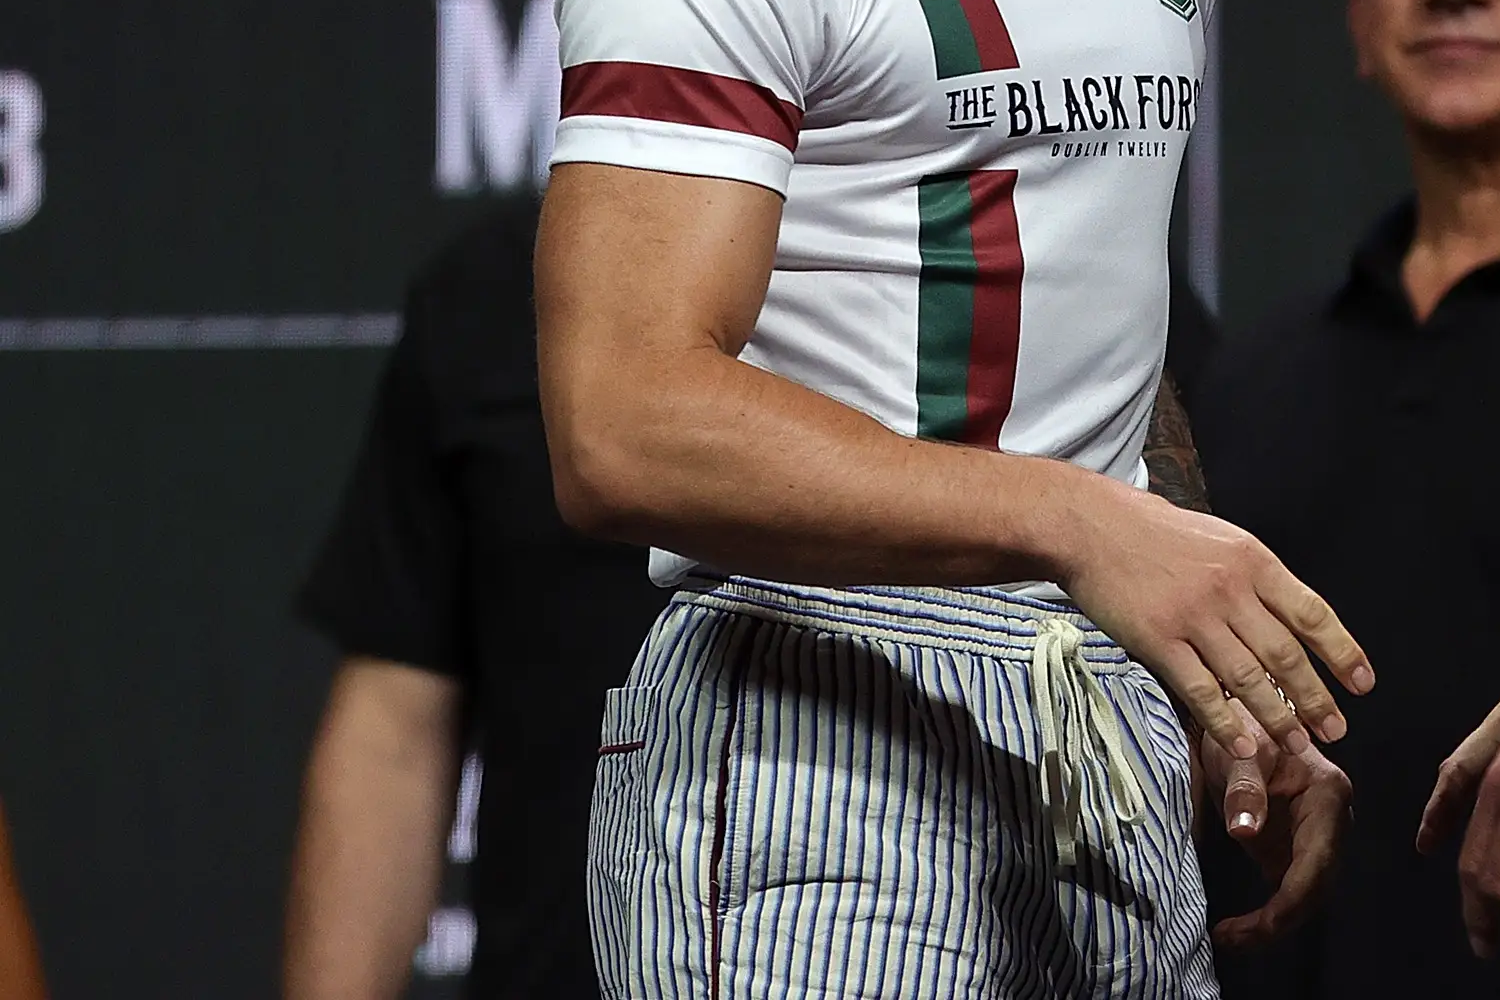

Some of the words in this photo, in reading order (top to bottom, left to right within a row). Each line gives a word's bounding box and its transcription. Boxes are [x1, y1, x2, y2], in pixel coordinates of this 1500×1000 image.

[945, 85, 997, 127] THE
[1006, 76, 1130, 138] BLACK
[1051, 142, 1108, 157] DUBLIN
[1118, 141, 1166, 157] TWELVE
